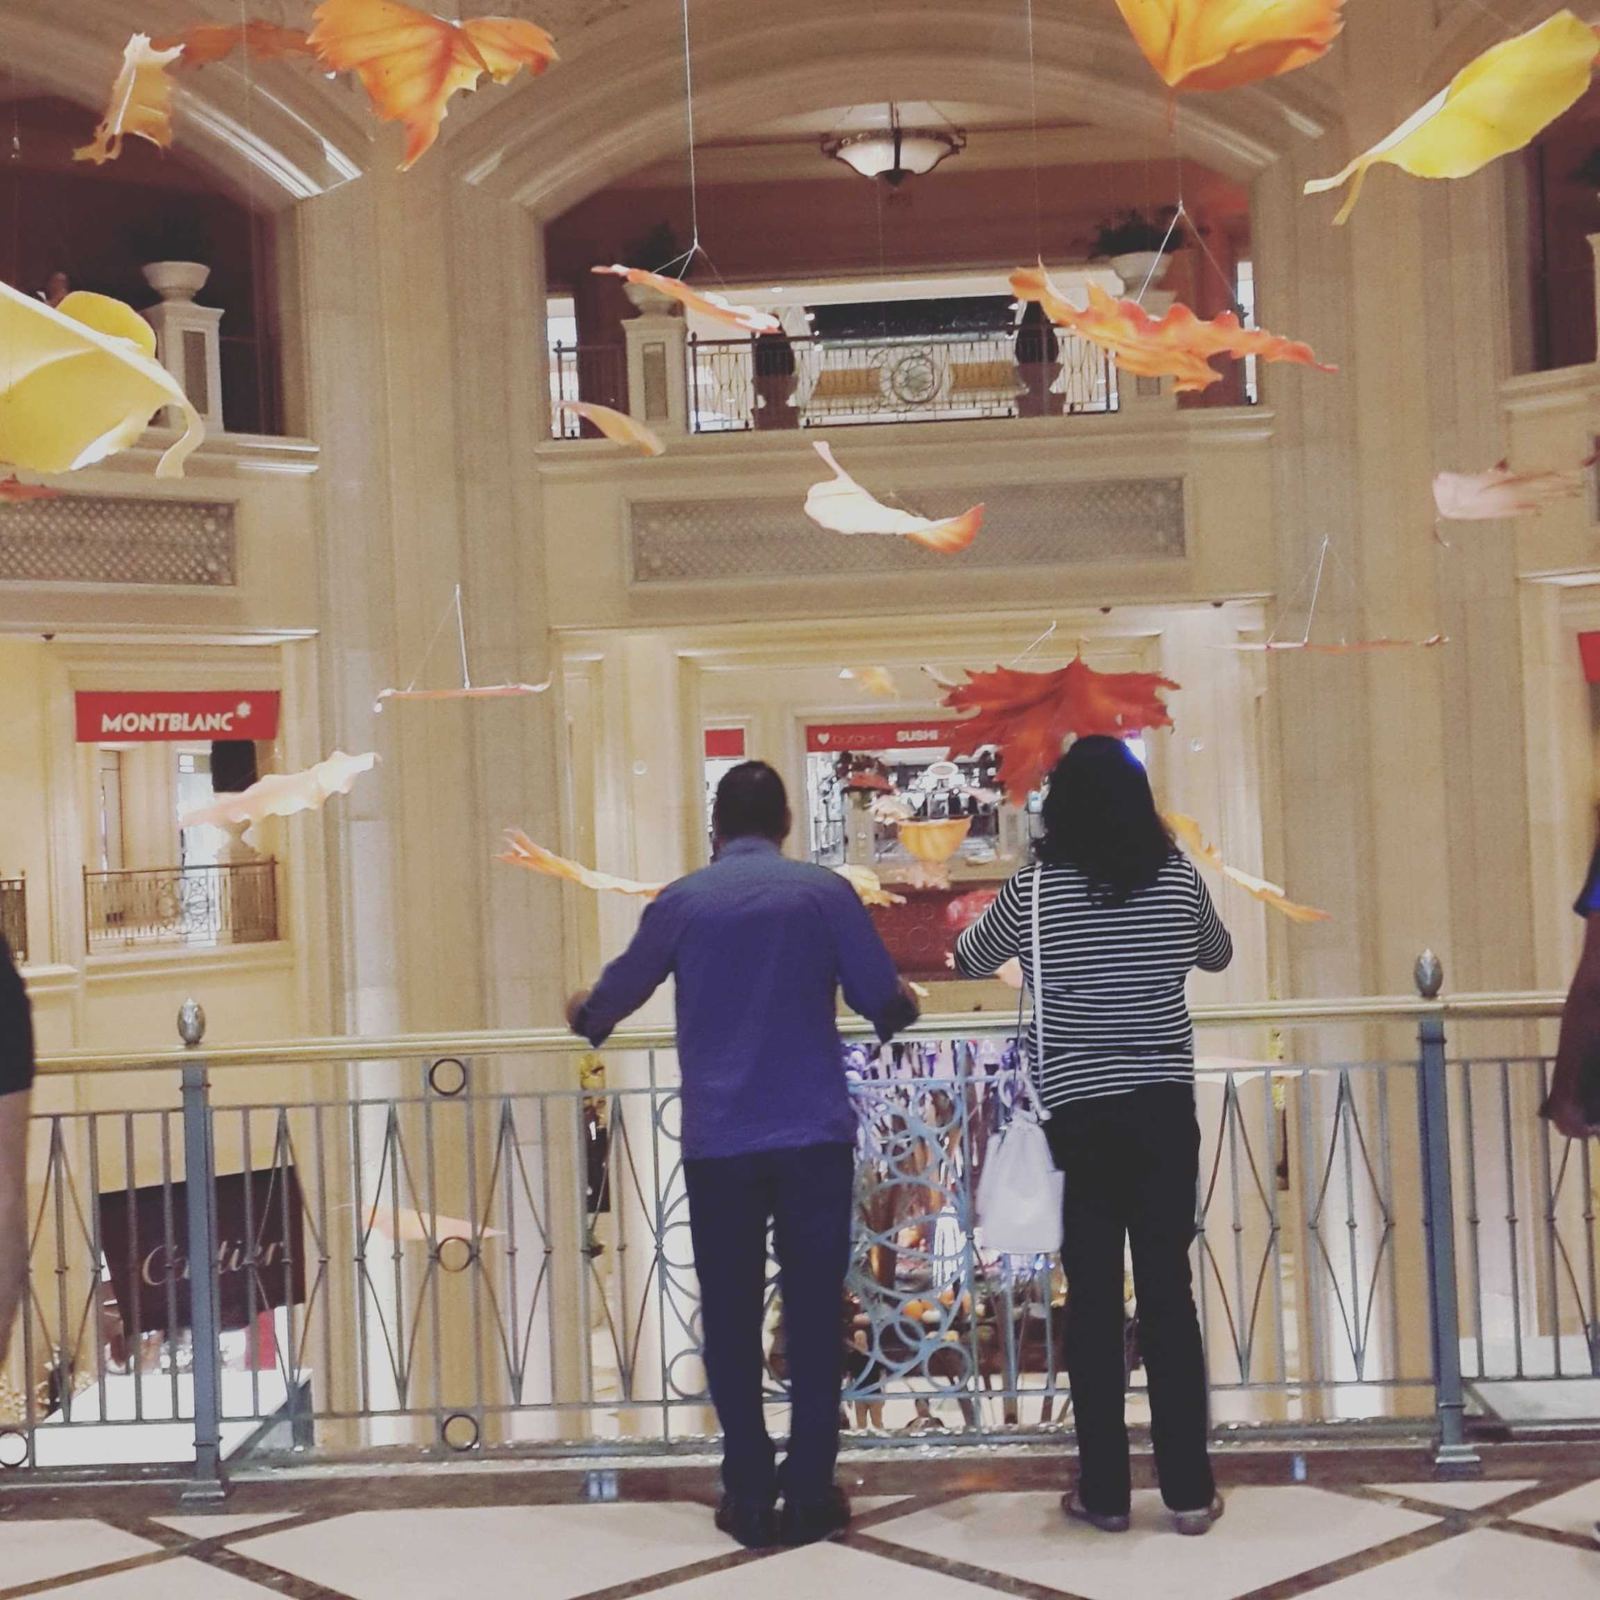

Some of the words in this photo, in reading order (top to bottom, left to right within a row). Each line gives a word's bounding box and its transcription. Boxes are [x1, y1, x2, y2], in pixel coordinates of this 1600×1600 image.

[101, 712, 234, 733] MONTBLANC
[896, 729, 939, 742] SUSHI
[142, 1240, 284, 1286] Catier
